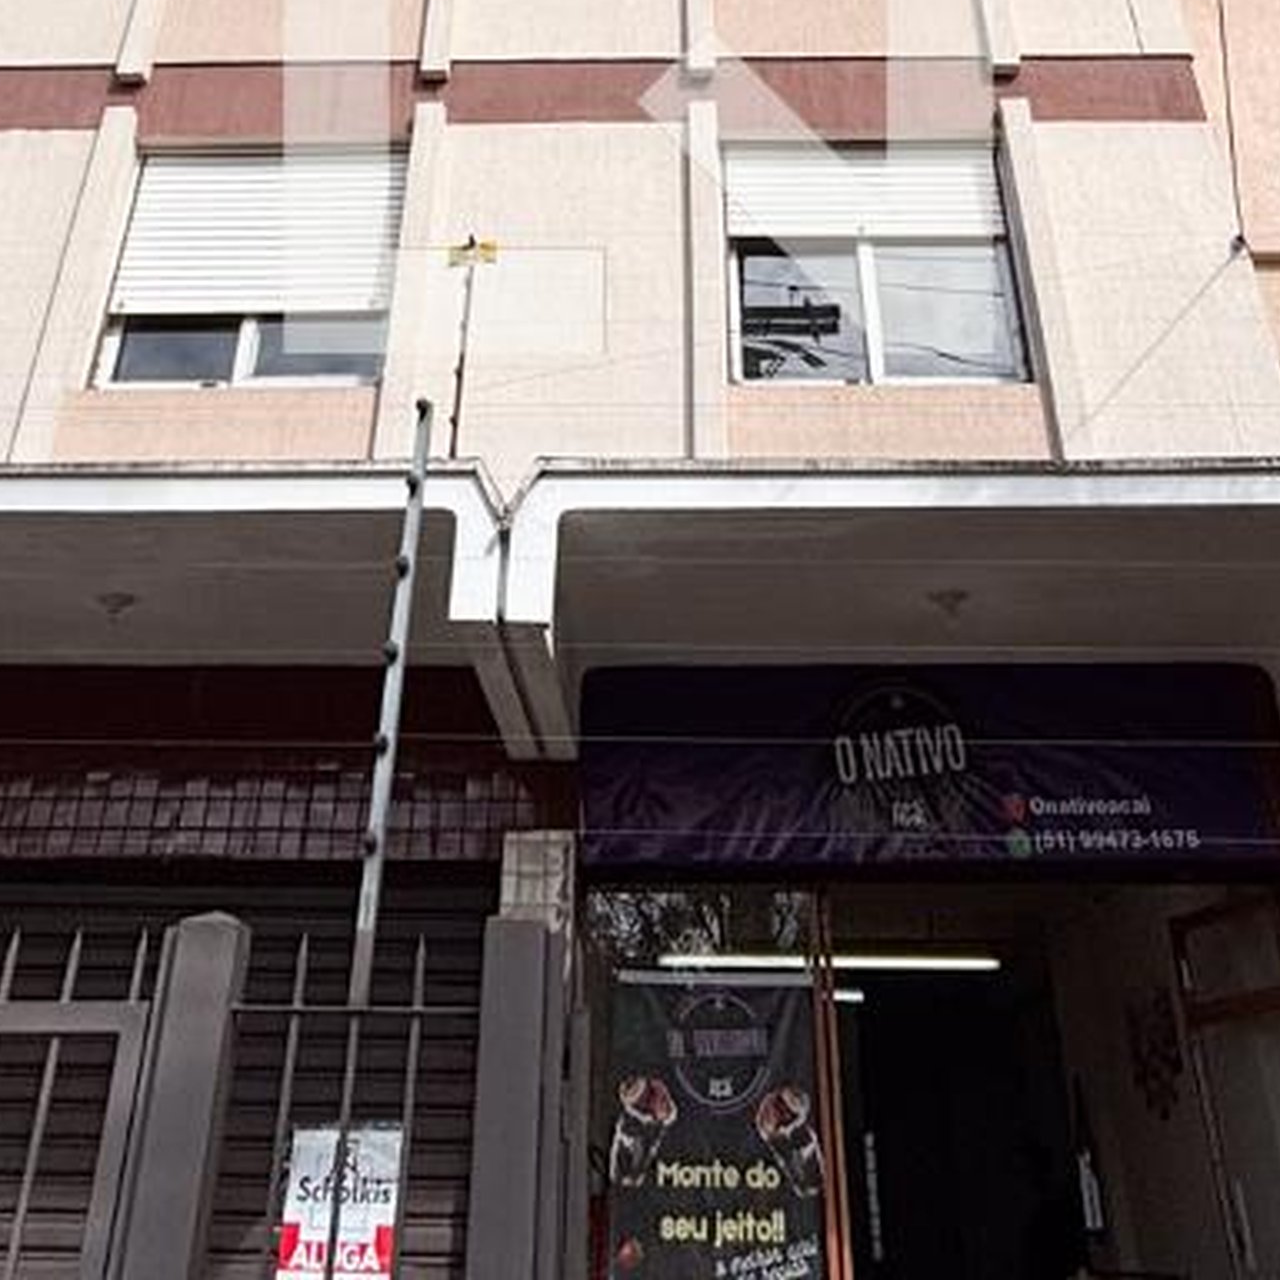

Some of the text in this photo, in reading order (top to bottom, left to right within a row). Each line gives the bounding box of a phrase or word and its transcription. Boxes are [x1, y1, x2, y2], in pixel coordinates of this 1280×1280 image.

[833, 723, 968, 784] O NATIVO
[656, 1158, 782, 1188] Monte do
[659, 1214, 709, 1241] seu
